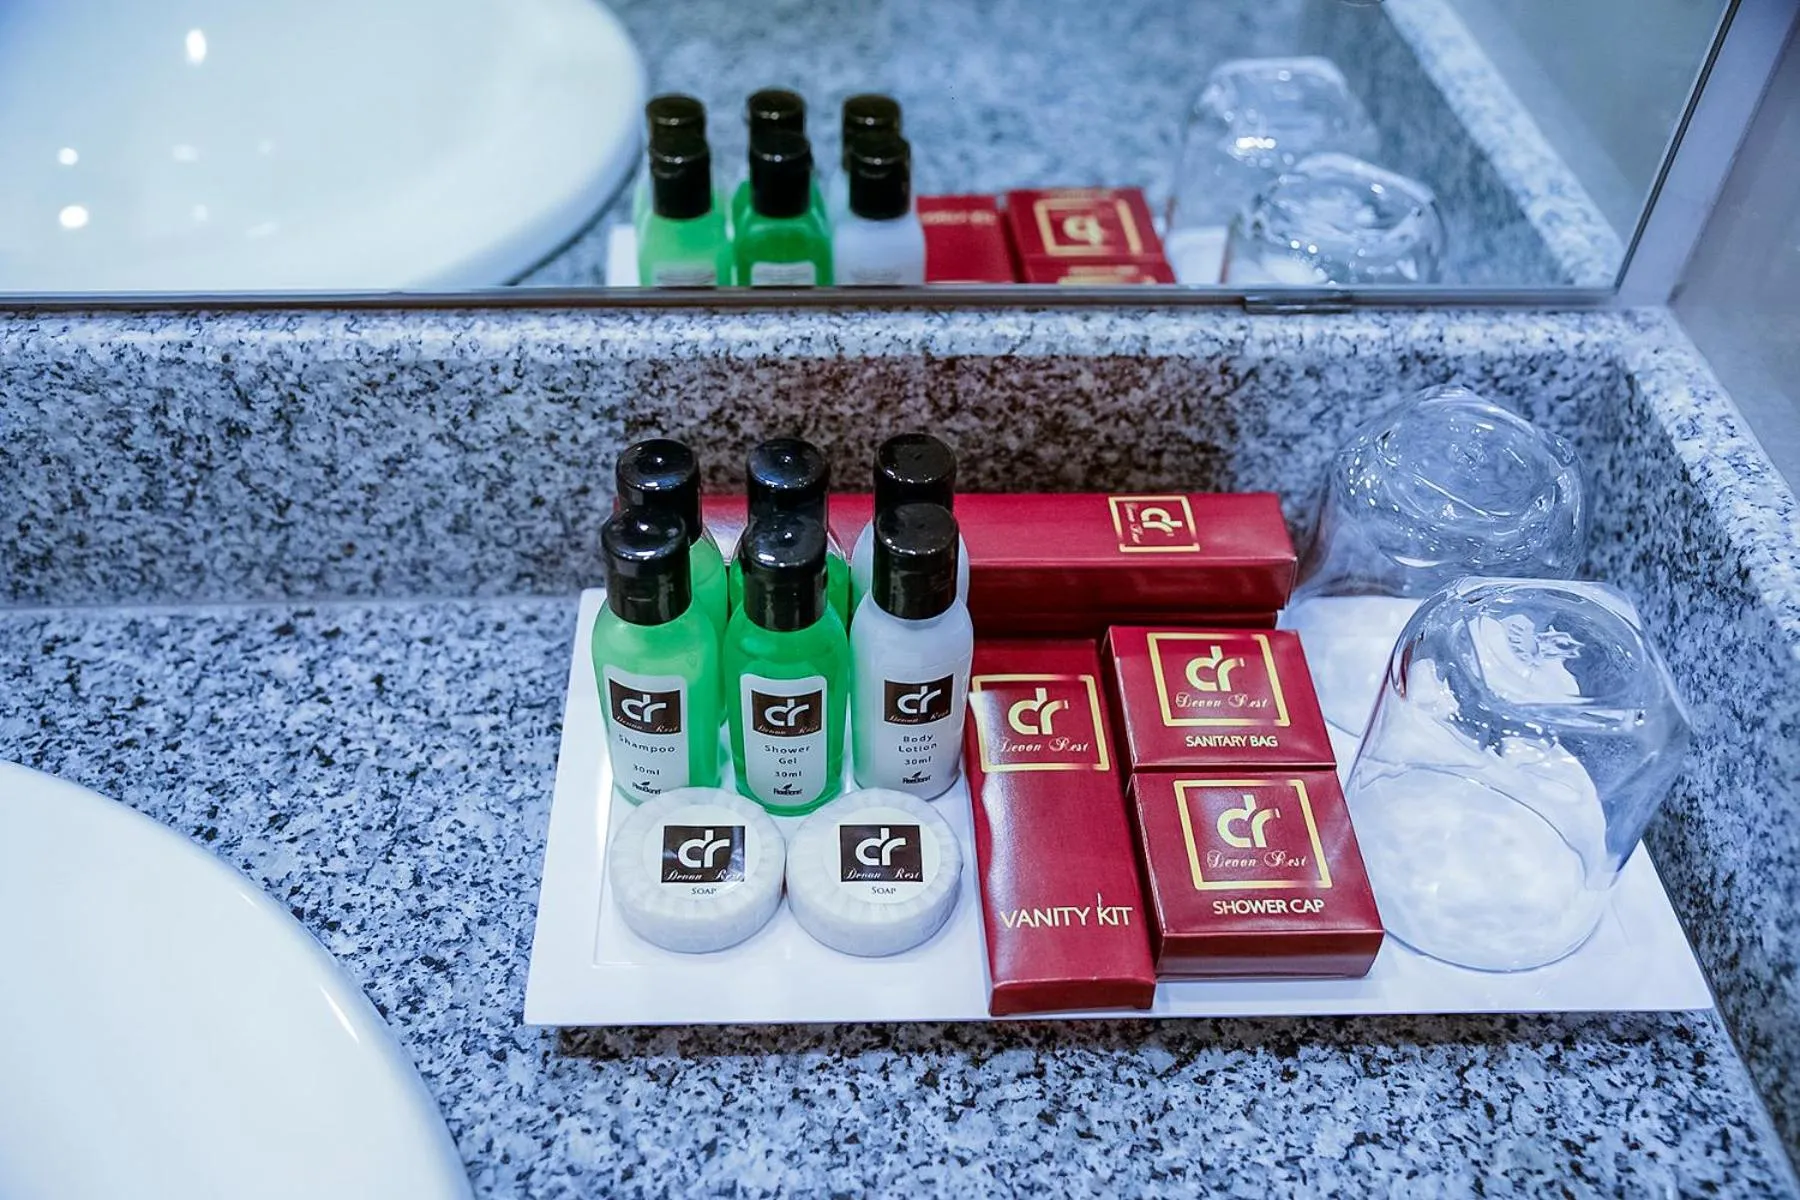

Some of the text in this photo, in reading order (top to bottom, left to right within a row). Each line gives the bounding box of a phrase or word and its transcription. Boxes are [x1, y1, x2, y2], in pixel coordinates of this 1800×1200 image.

[619, 733, 675, 754] Shampoo
[903, 734, 934, 743] Body
[1185, 735, 1278, 748] SANITARY BAG
[764, 744, 810, 754] Shower
[898, 742, 937, 753] Lotion
[778, 757, 797, 765] Gel
[905, 756, 932, 766] 30ml
[633, 763, 660, 776] 30ml
[775, 770, 802, 778] 30ml
[999, 892, 1133, 928] VANITY KIT
[1212, 899, 1325, 914] SHOWER CAP
